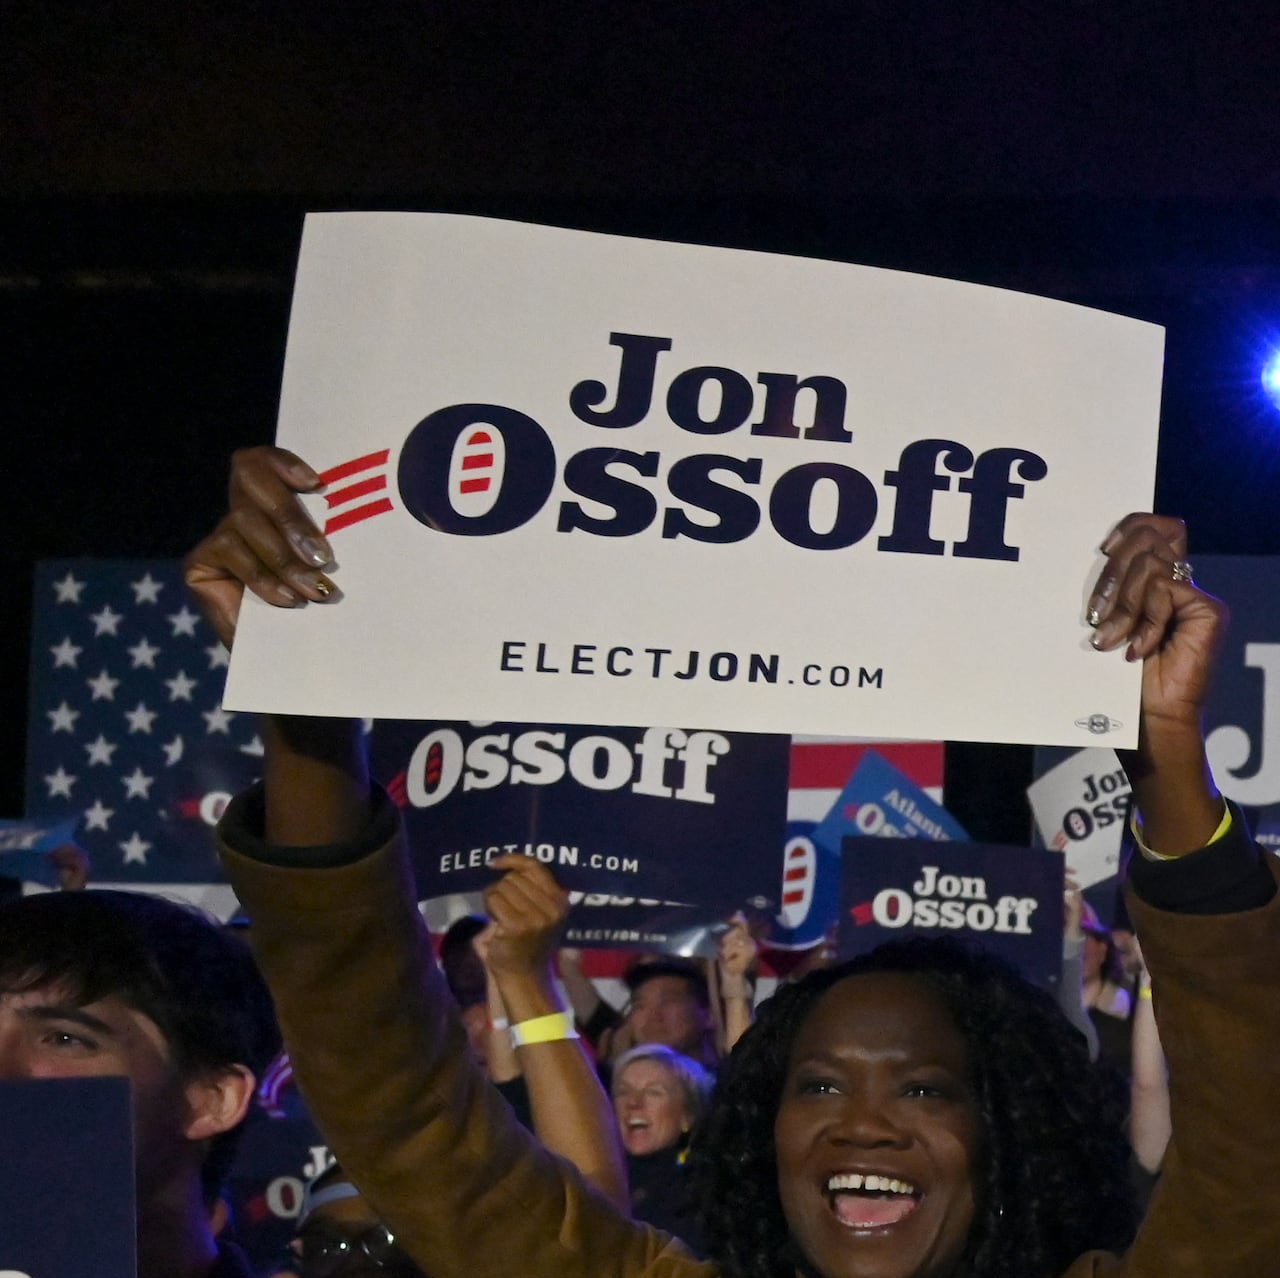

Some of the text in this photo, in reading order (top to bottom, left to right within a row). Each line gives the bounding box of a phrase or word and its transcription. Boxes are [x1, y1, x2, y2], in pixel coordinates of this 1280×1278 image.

[569, 332, 853, 443] Jon
[398, 402, 1049, 562] Ossoff
[500, 640, 885, 690] ELECTJON.COM
[406, 727, 731, 808] Ossoff
[871, 888, 1038, 934] Ossoff
[913, 866, 988, 899] Jon
